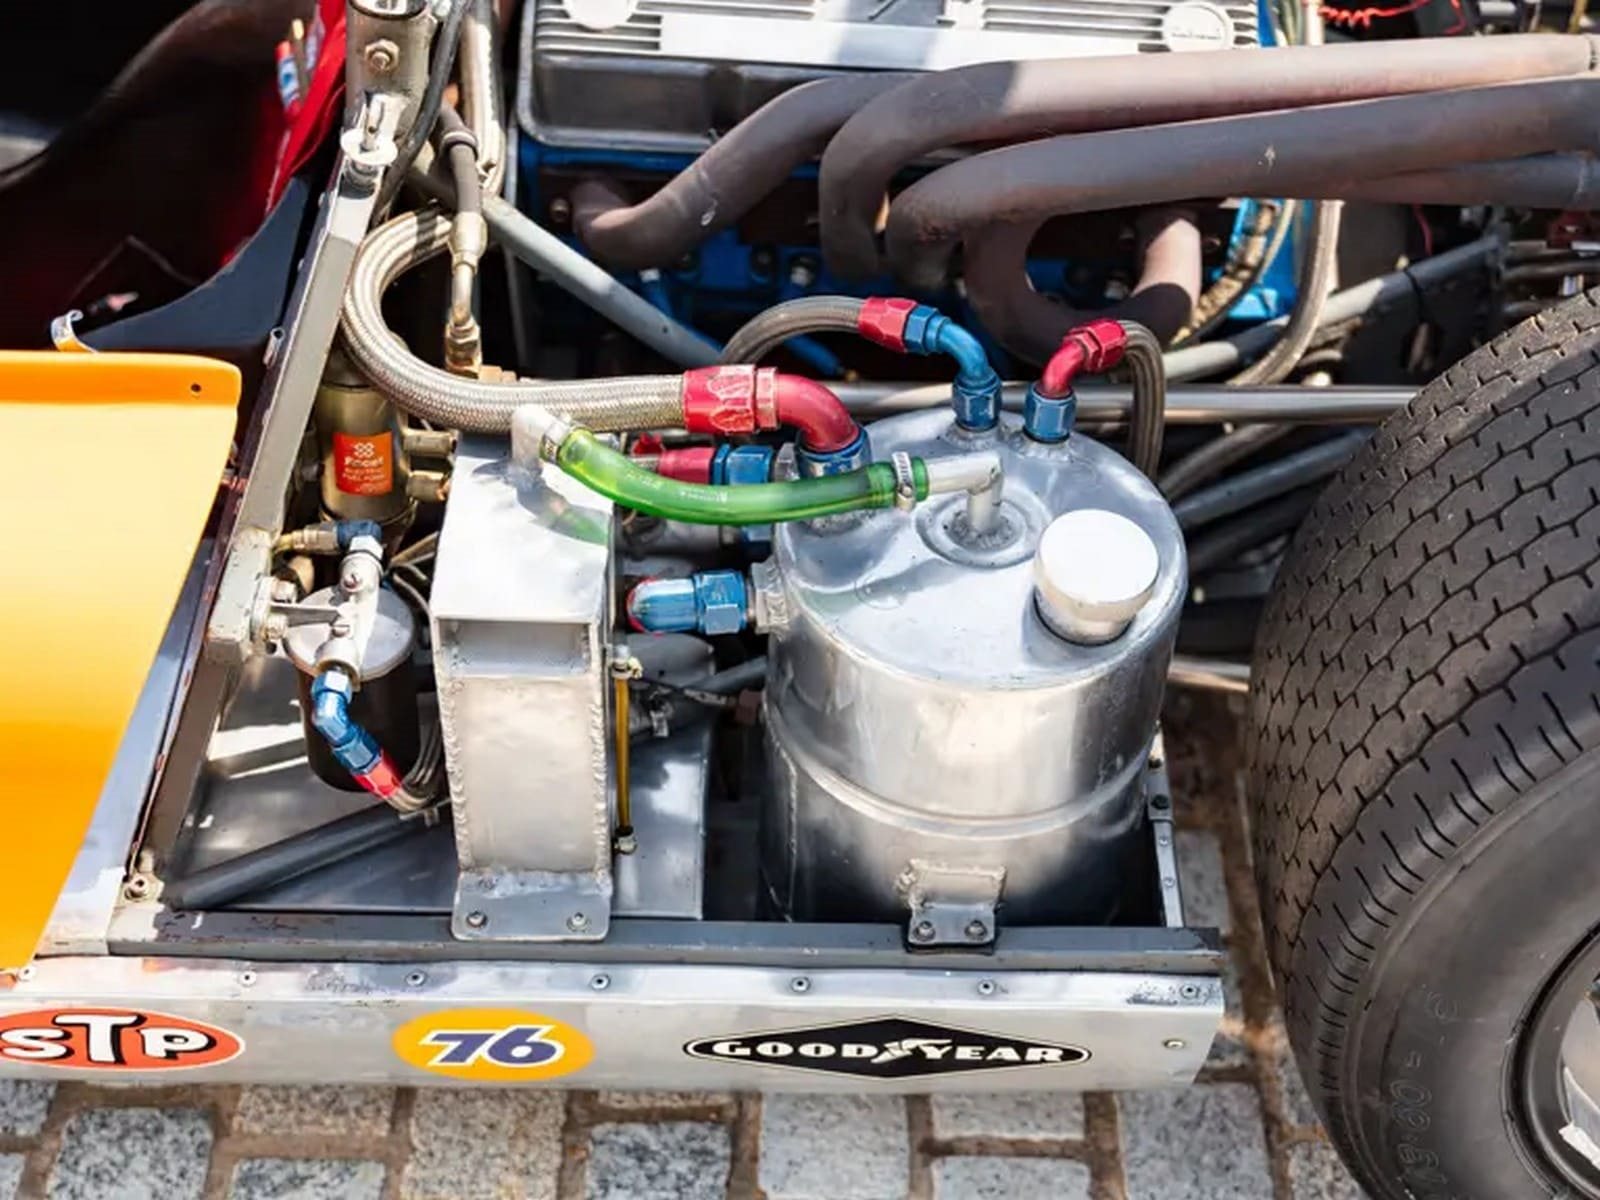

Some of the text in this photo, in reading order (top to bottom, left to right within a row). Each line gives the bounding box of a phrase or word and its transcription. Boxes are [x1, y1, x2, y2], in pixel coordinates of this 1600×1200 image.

[0, 1012, 209, 1064] STP
[416, 1024, 564, 1068] 76
[711, 1038, 1063, 1063] GOODYEAR
